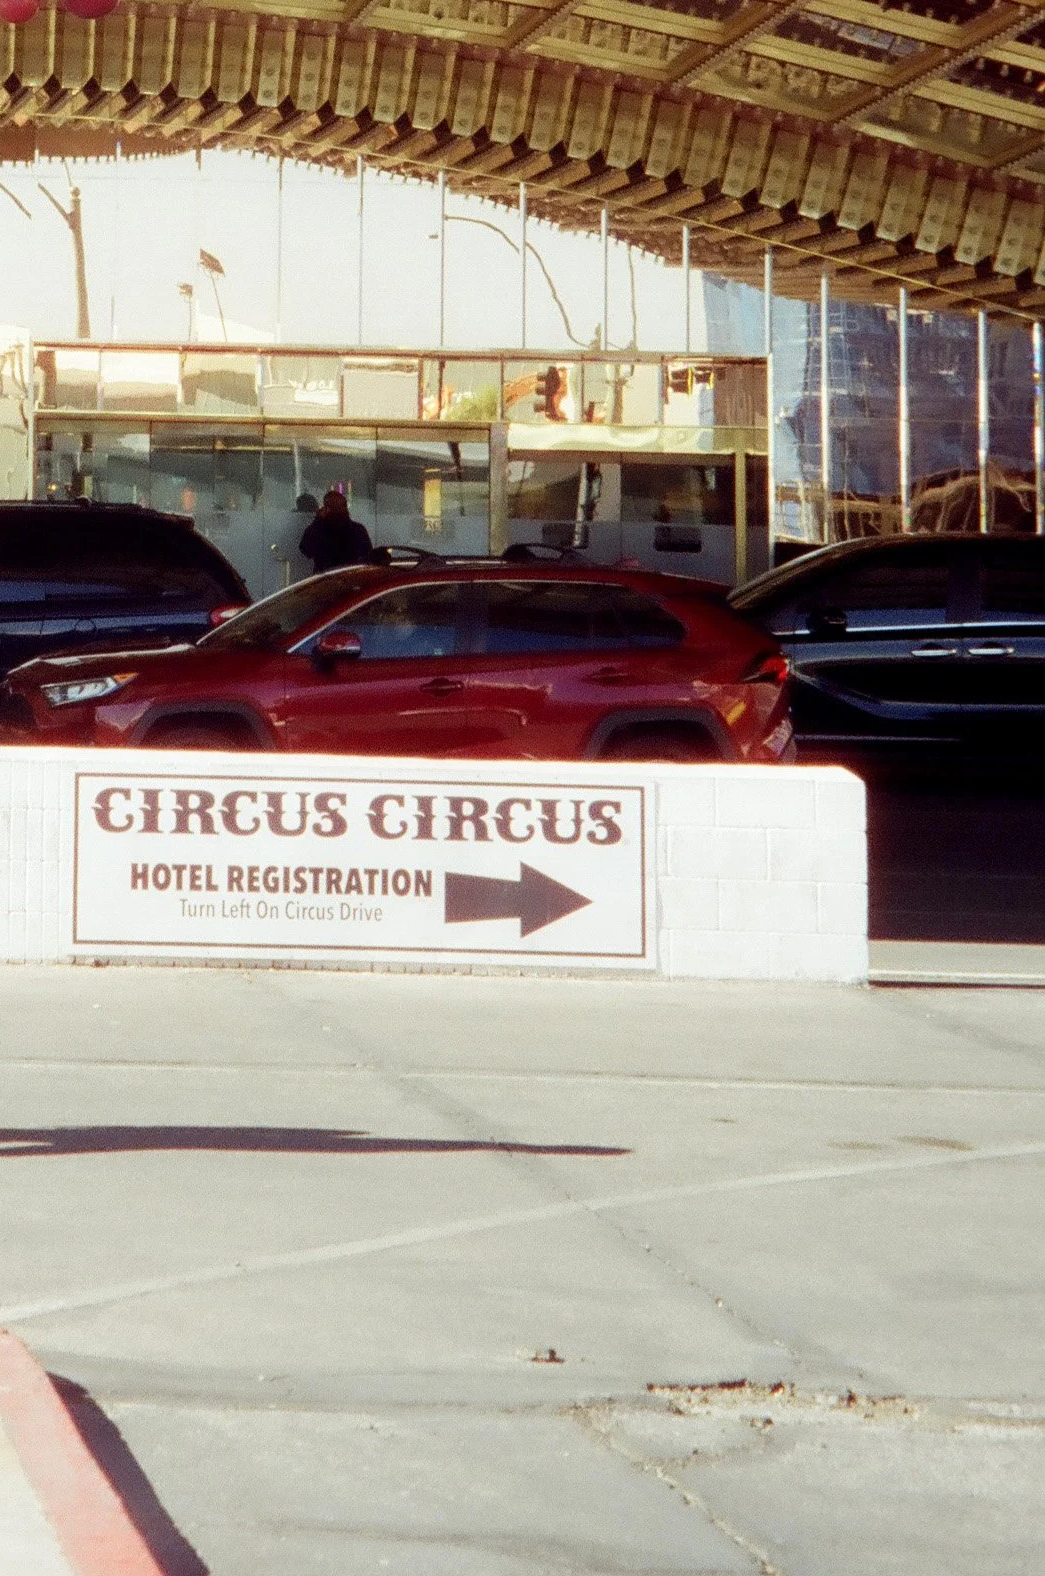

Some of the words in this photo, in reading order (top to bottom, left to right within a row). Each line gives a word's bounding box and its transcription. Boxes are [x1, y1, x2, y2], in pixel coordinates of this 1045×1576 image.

[92, 786, 349, 838] CIRCUS
[365, 793, 623, 846] CIRCUS
[129, 862, 219, 894] HOTEL
[227, 865, 433, 898] REGISTRATION
[178, 898, 217, 919] Turn
[221, 899, 252, 921] Left
[256, 900, 280, 921] On
[284, 900, 335, 922] Circus
[339, 901, 384, 923] Drive
